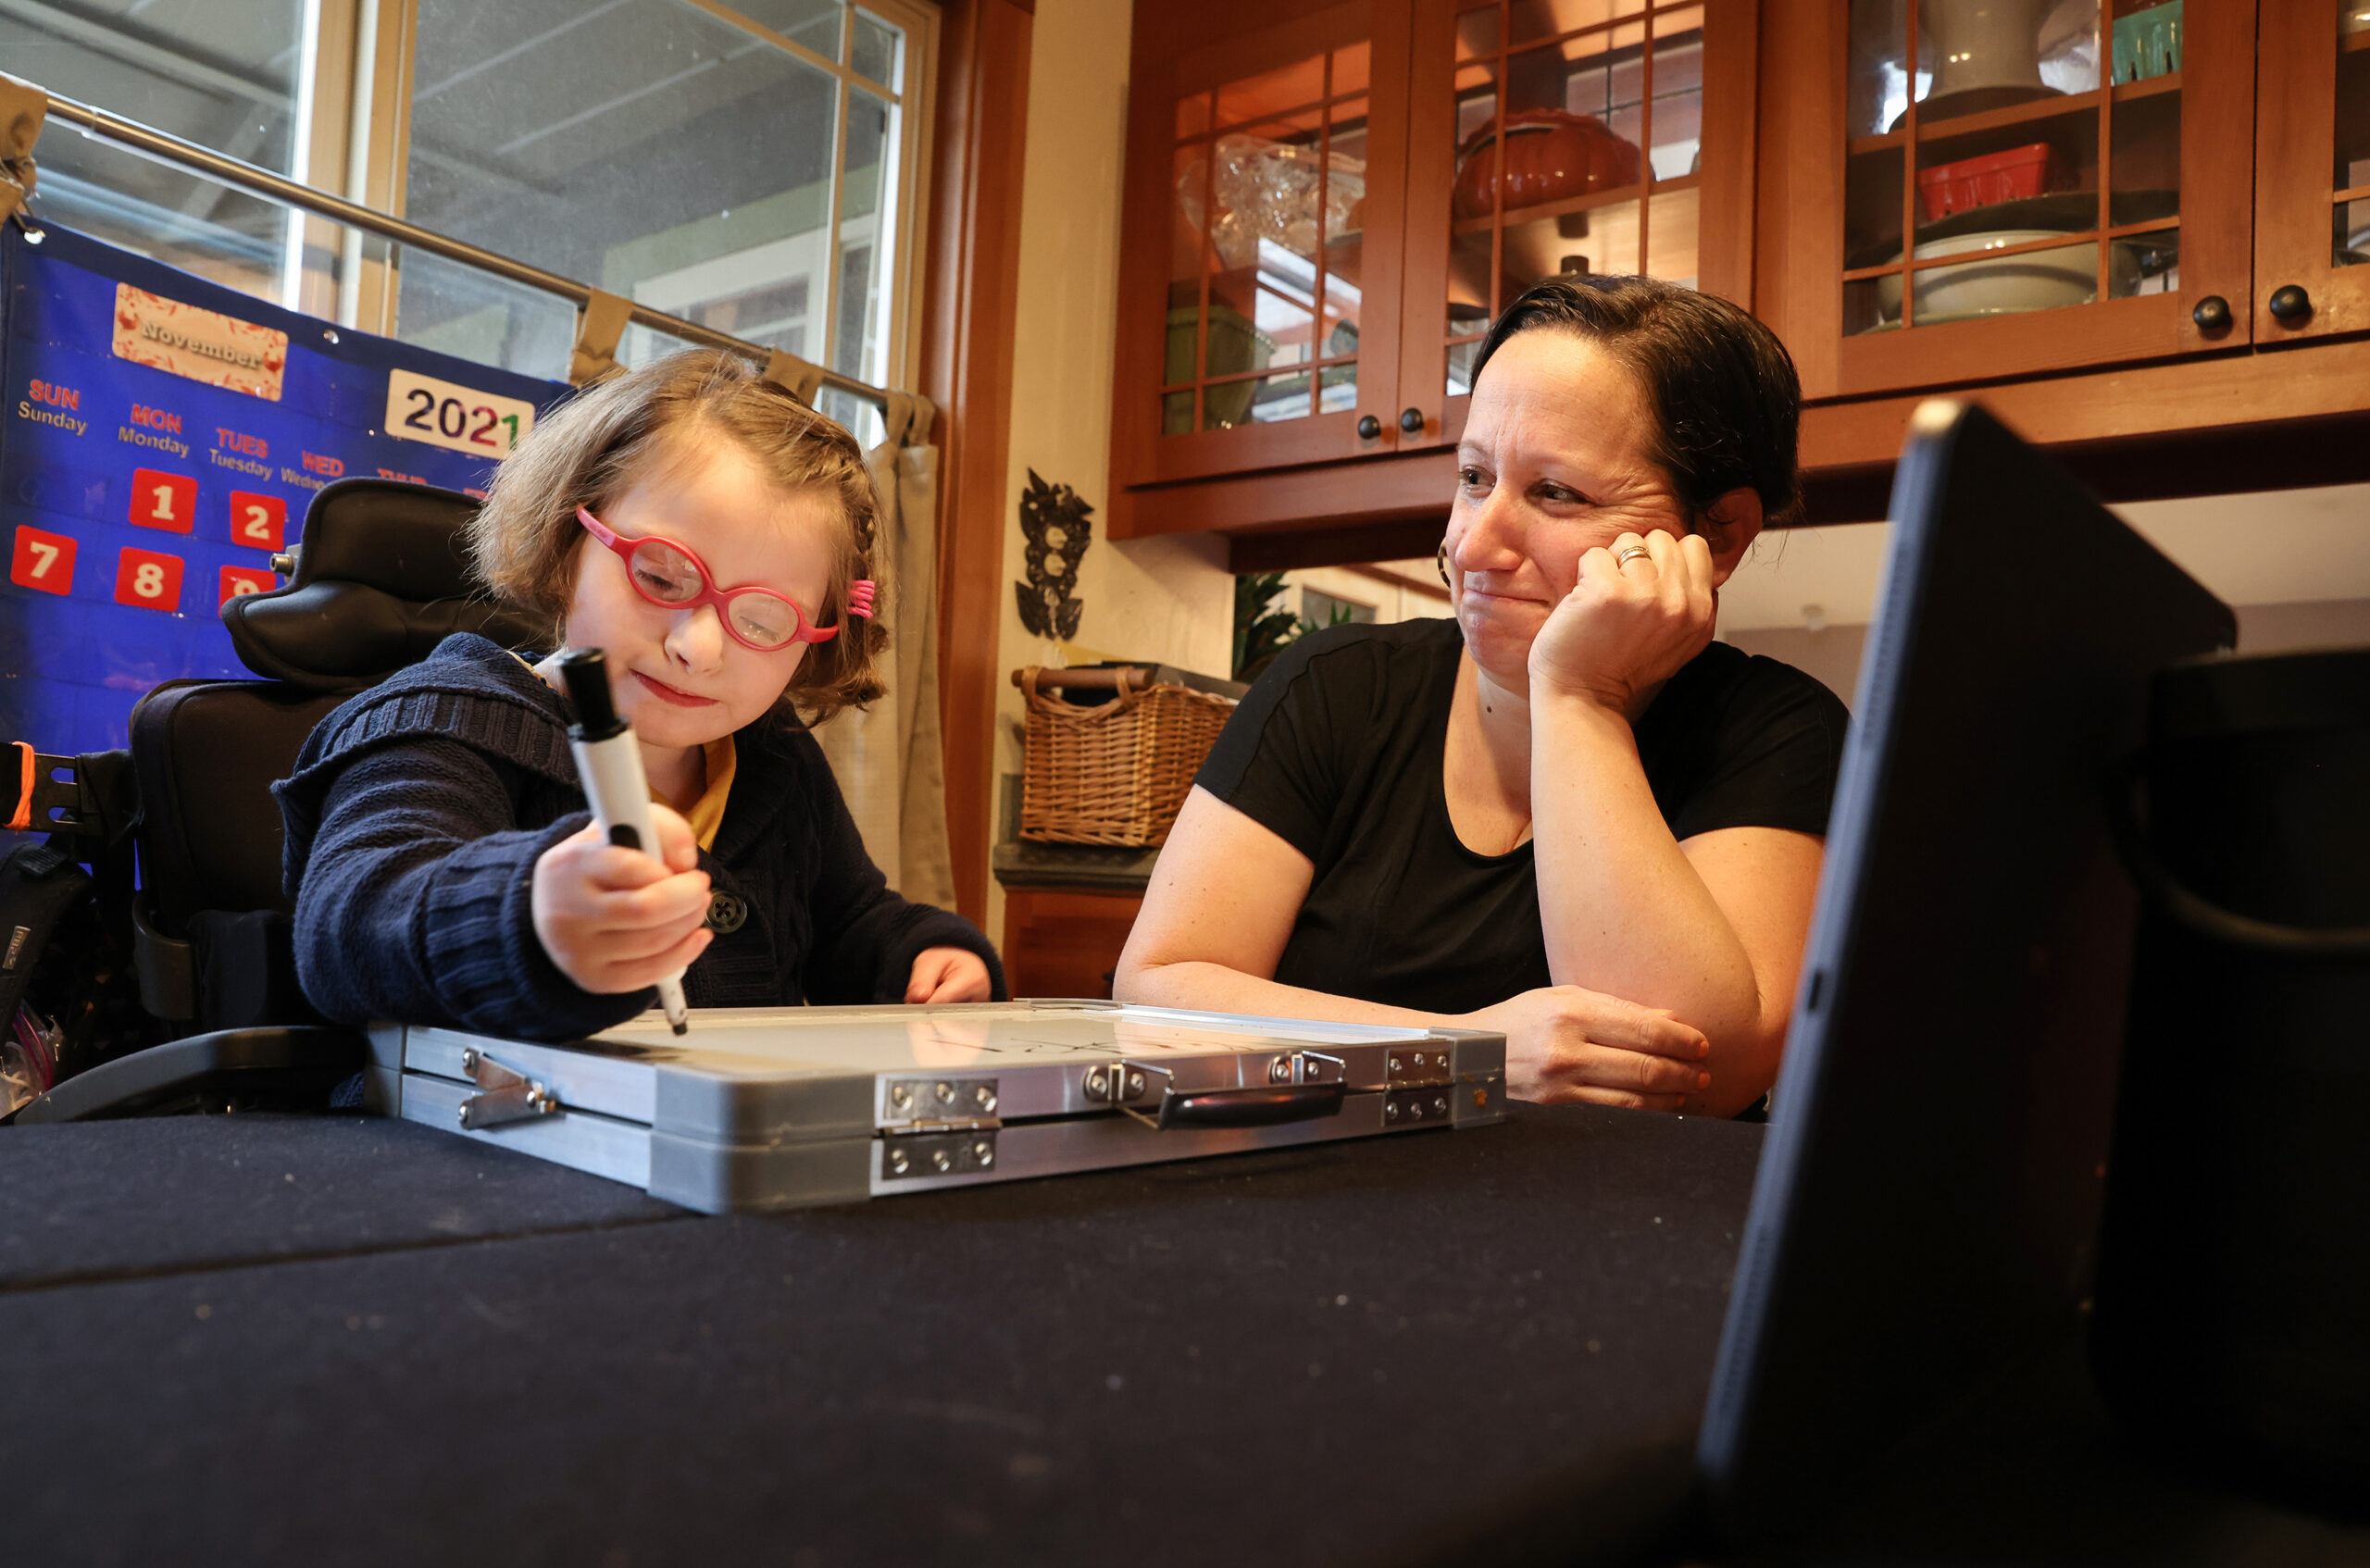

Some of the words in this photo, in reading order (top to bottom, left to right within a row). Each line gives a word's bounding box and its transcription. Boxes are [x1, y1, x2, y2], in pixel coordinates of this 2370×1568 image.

[142, 323, 263, 370] November
[29, 379, 80, 410] SUN
[18, 401, 88, 437] Sunday
[131, 404, 182, 434] MON
[405, 389, 518, 451] 2021
[118, 426, 190, 459] Monday
[216, 427, 268, 458] TUES
[208, 448, 273, 482] Tuesday
[302, 451, 344, 477] WED
[151, 485, 175, 520] 1
[244, 505, 270, 540] 2
[30, 541, 59, 579] 7
[133, 563, 164, 598] 8
